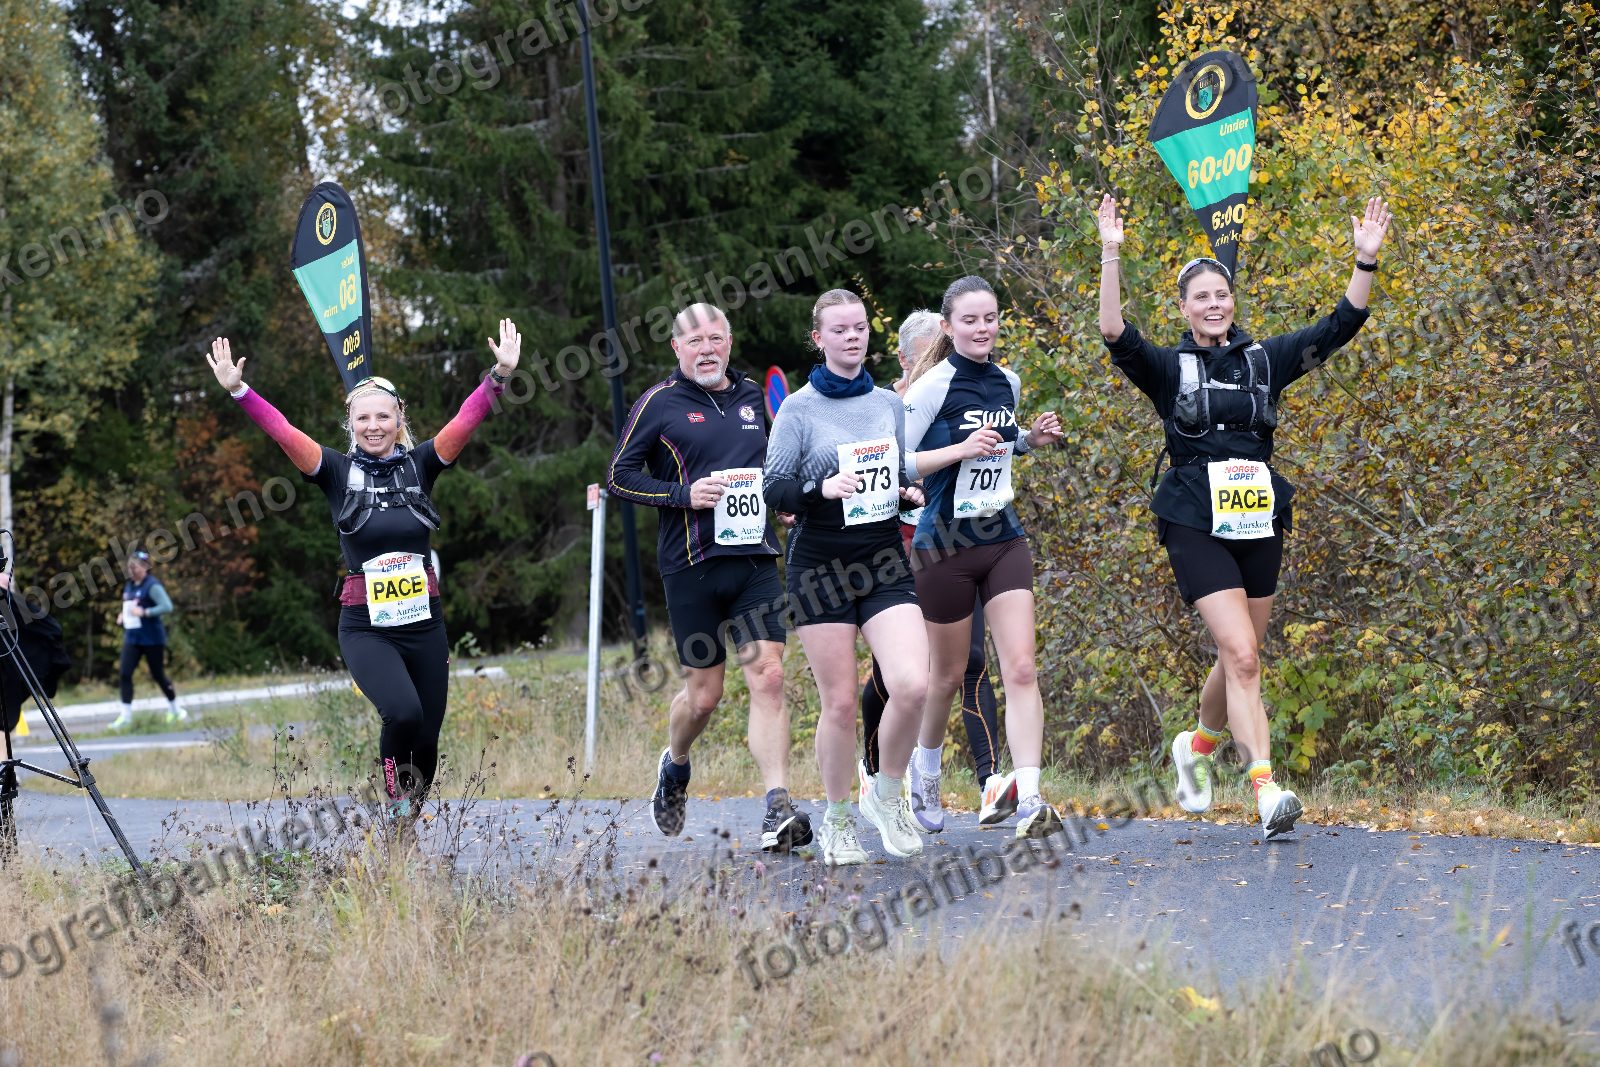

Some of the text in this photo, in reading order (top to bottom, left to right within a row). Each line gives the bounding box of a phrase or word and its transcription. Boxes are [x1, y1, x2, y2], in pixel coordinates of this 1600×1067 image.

[1219, 117, 1249, 137] Under
[1187, 143, 1253, 190] 60:00
[1211, 203, 1246, 231] 6:00
[959, 405, 1019, 430] SWIX
[851, 444, 890, 456] NORGES
[857, 452, 886, 464] LØPET
[727, 473, 757, 482] NORGES
[729, 480, 754, 489] LØPET
[854, 465, 892, 495] 573
[969, 468, 1003, 491] 707
[726, 493, 760, 518] 860
[1218, 489, 1268, 510] PACE
[1236, 520, 1270, 530] Aurskog
[378, 555, 412, 566] NORGES
[381, 562, 408, 573] LØPET
[373, 575, 423, 601] PACE
[396, 603, 428, 617] Aurskog
